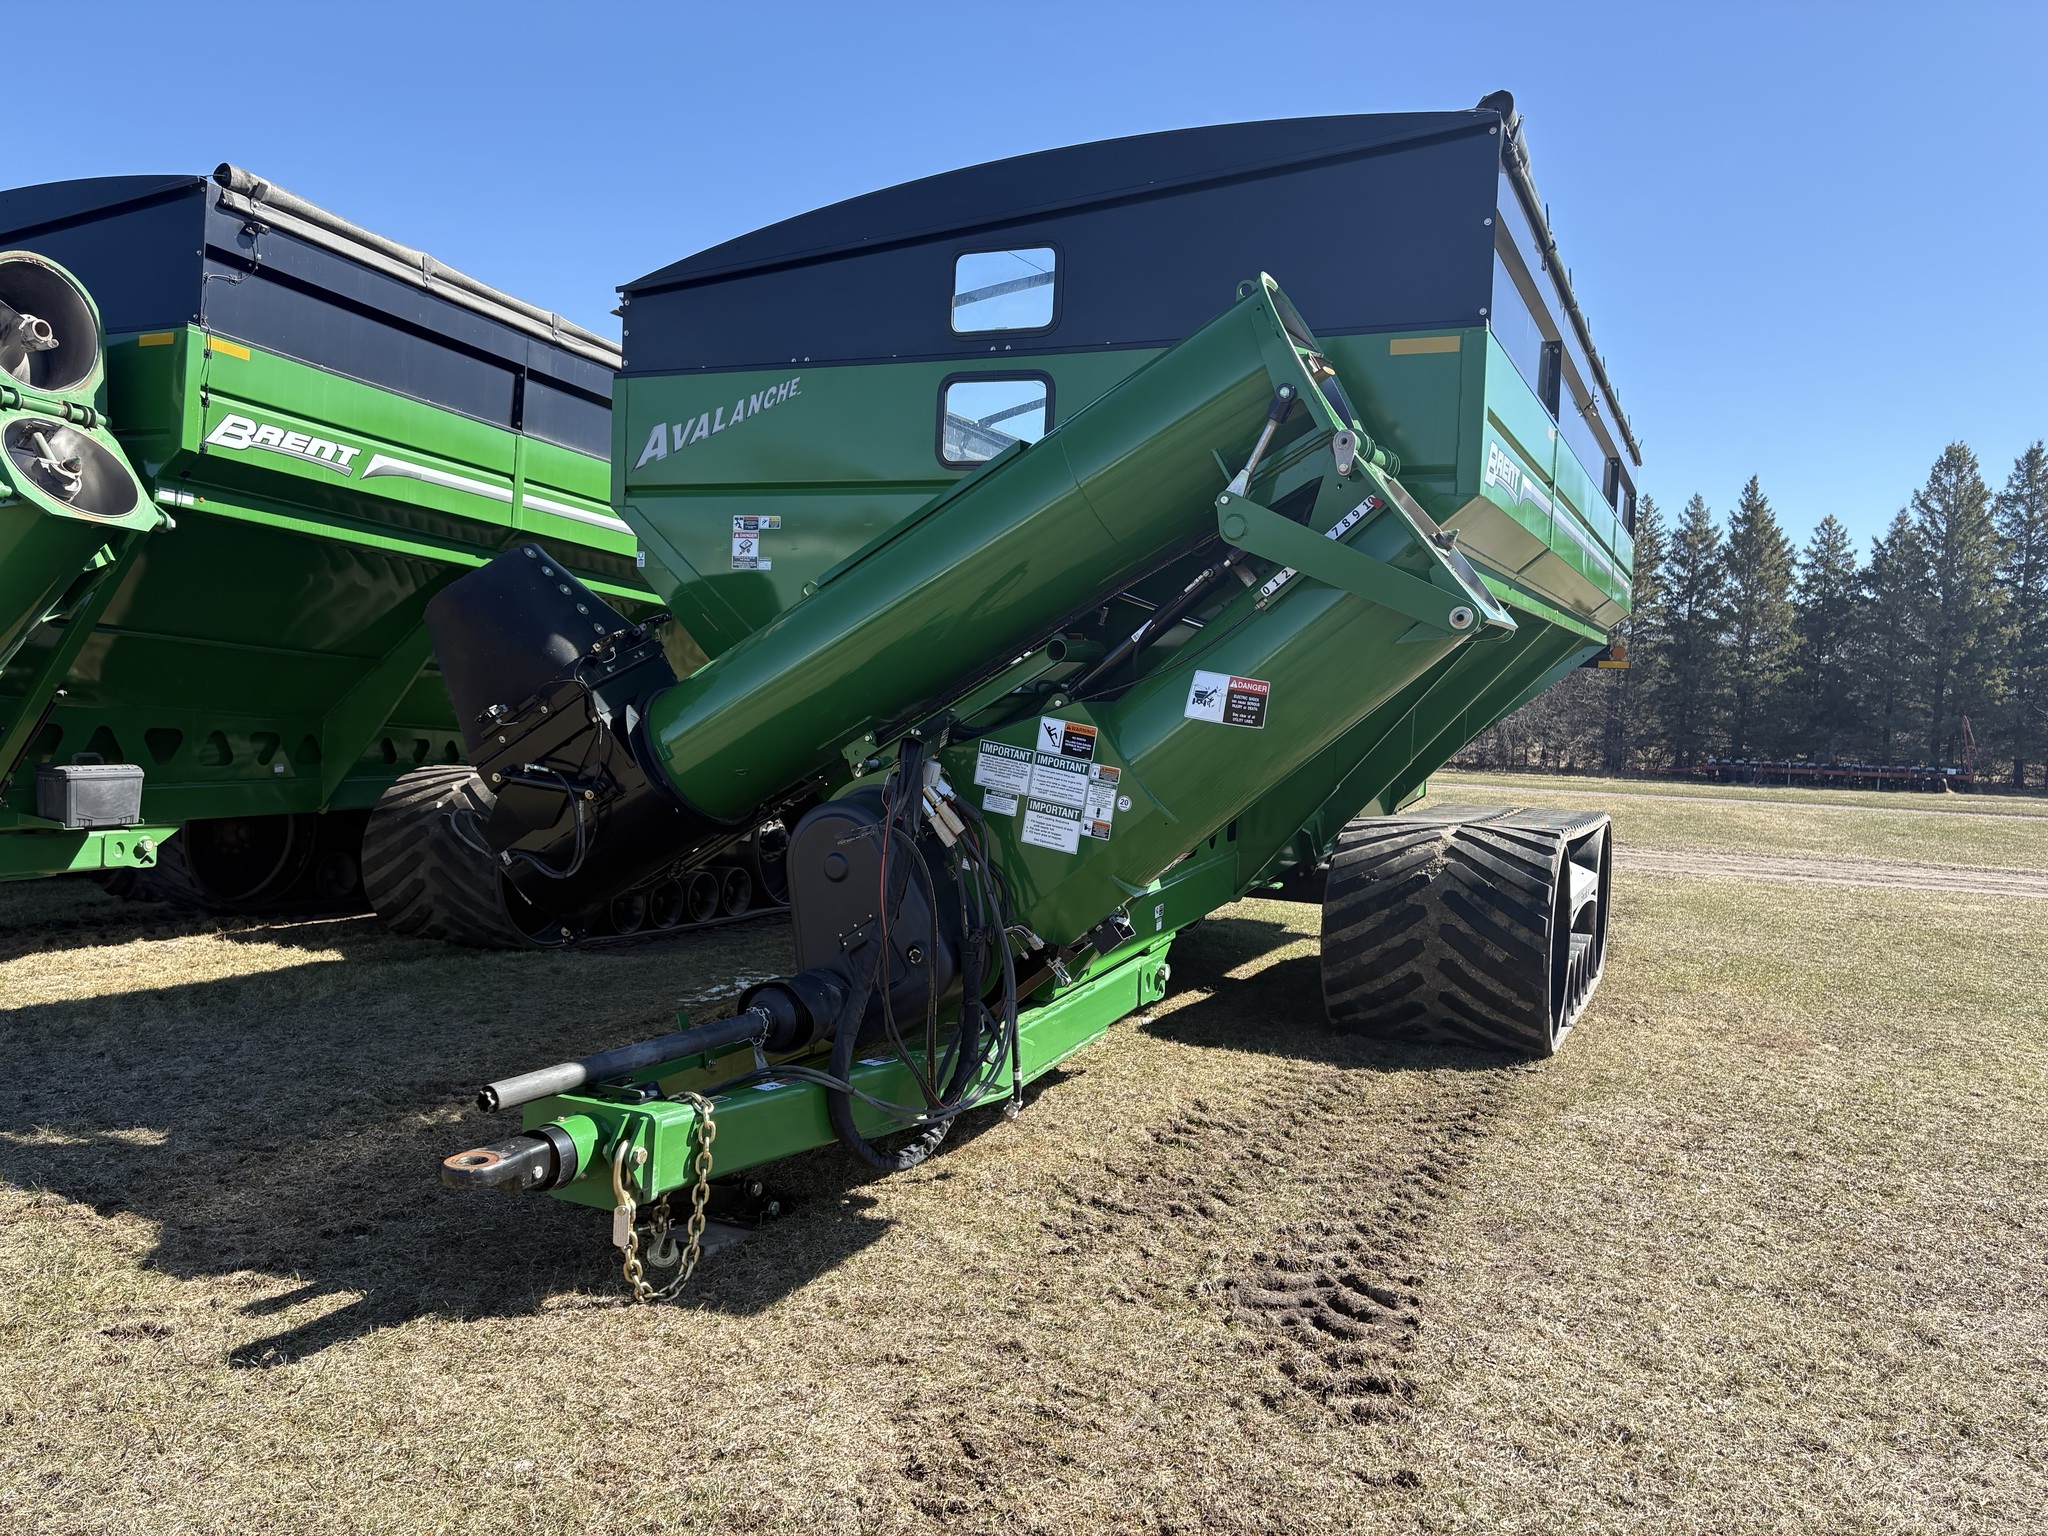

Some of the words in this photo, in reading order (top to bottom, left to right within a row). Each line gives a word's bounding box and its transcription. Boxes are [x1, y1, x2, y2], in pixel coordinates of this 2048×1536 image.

[631, 376, 801, 473] AVALANCHE
[205, 412, 362, 467] BRENT
[1484, 440, 1521, 490] BRENT
[1331, 527, 1339, 537] 7
[1341, 518, 1351, 528] 8
[1351, 509, 1361, 520] 9
[1262, 586, 1271, 595] 0
[1271, 577, 1281, 588] 1
[1281, 569, 1291, 580] 2
[1237, 682, 1267, 692] DANGER
[982, 743, 1031, 761] IMPORTANT
[1037, 755, 1087, 773] IMPORTANT
[1029, 800, 1080, 819] IMPORTANT
